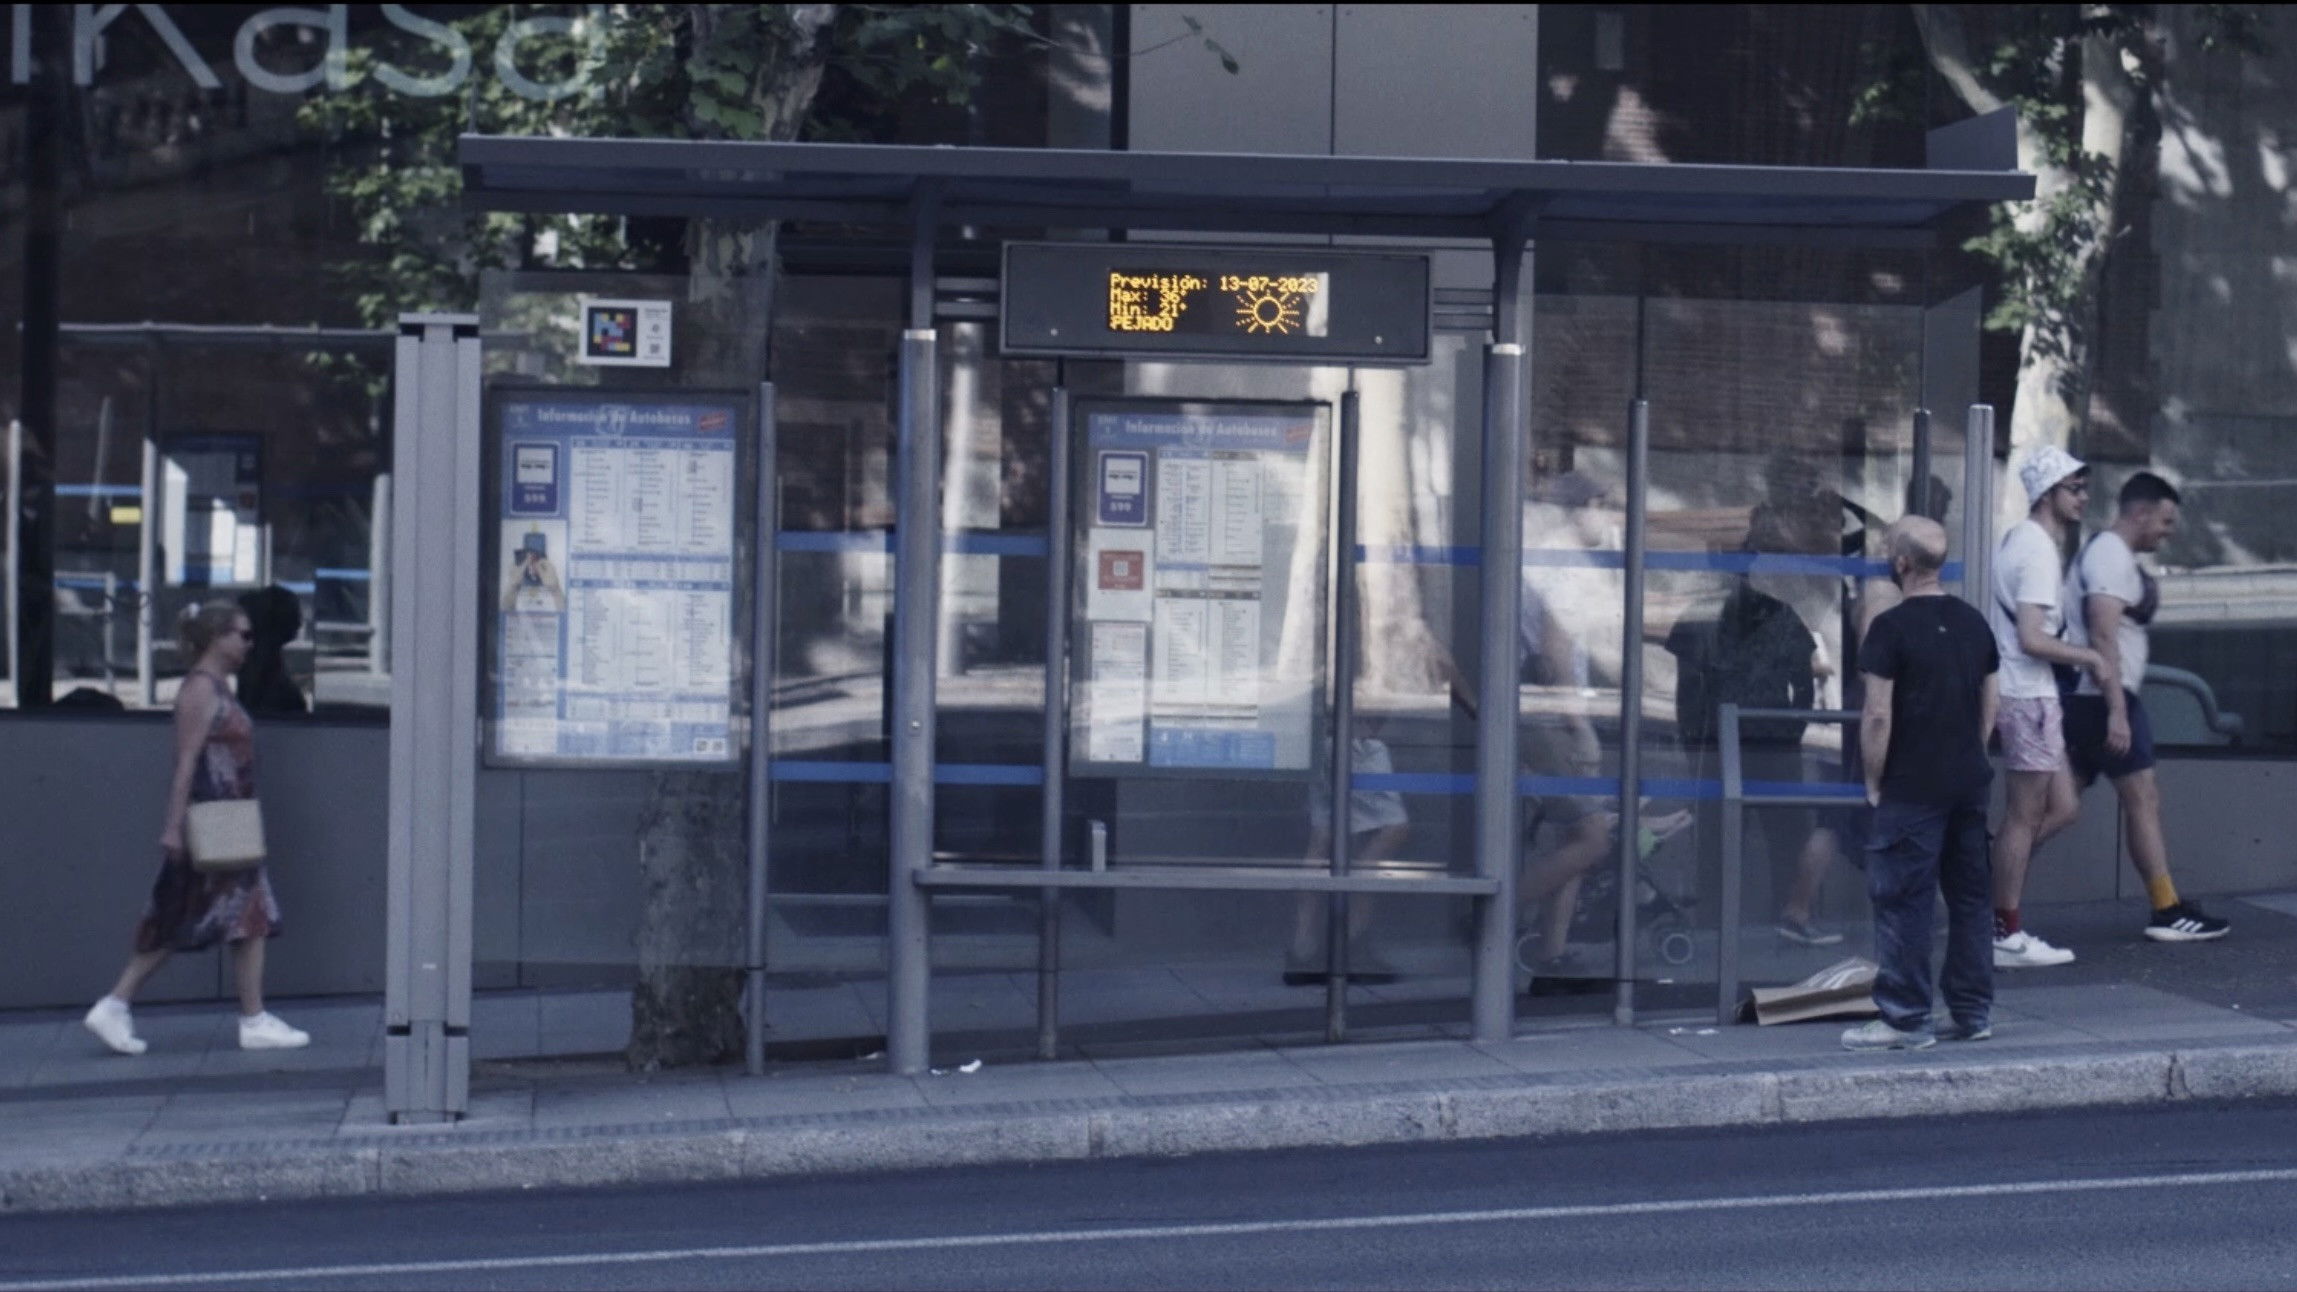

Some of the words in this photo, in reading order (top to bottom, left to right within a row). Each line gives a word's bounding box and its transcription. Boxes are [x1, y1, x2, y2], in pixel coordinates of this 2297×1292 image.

[1110, 273, 1208, 291] Previsión:
[1220, 276, 1319, 293] 13-07-2023
[1110, 288, 1148, 303] Max:
[1110, 302, 1148, 317] Min:
